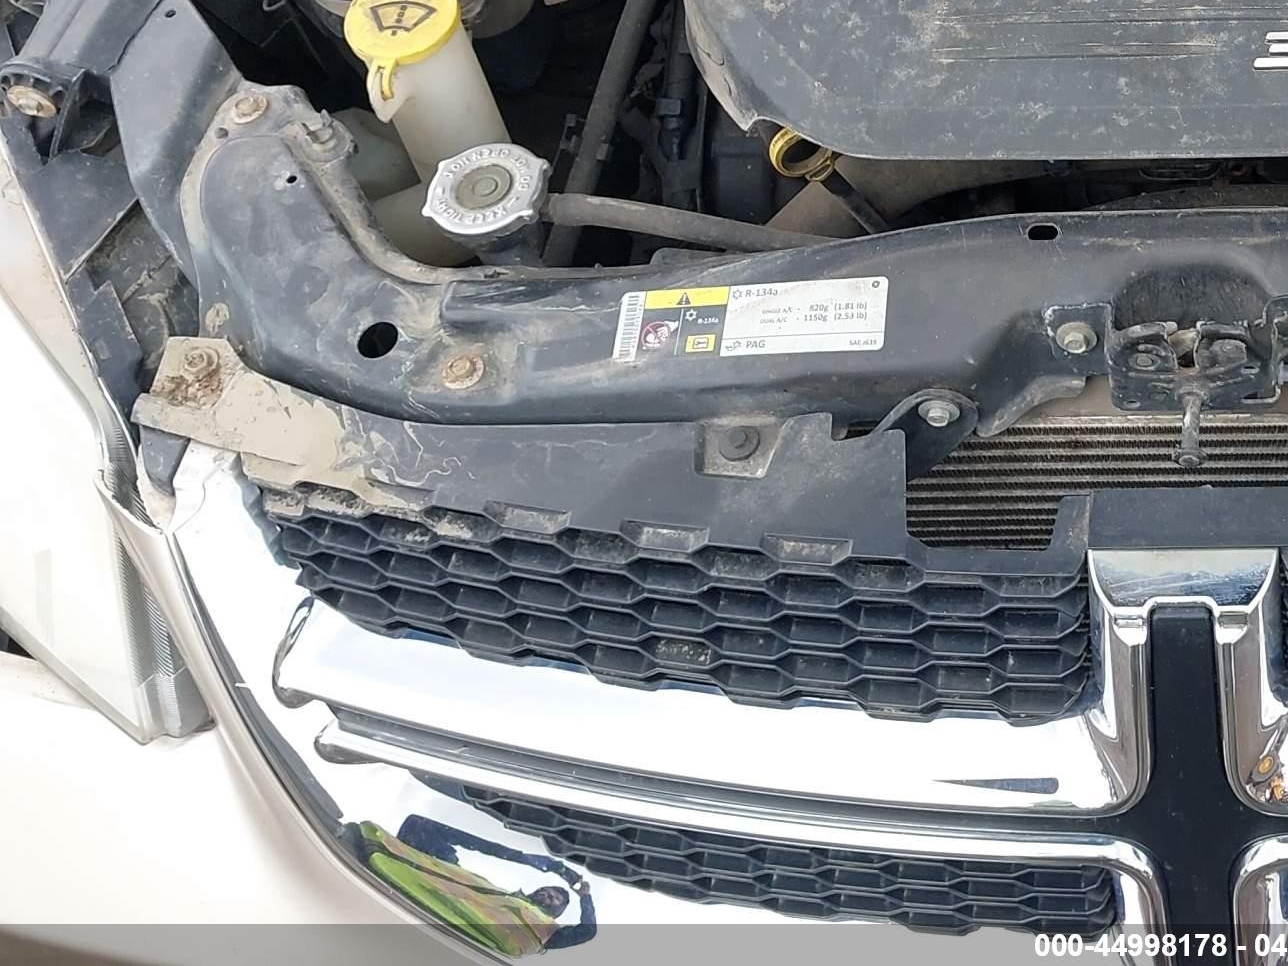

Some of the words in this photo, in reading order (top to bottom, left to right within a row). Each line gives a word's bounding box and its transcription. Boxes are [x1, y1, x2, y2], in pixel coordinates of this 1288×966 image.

[745, 288, 778, 297] R-134a
[834, 302, 854, 311] (1.81
[857, 301, 867, 310] lb)
[804, 314, 828, 322] 1150g
[857, 311, 867, 320] lb)
[746, 340, 766, 348] PAG
